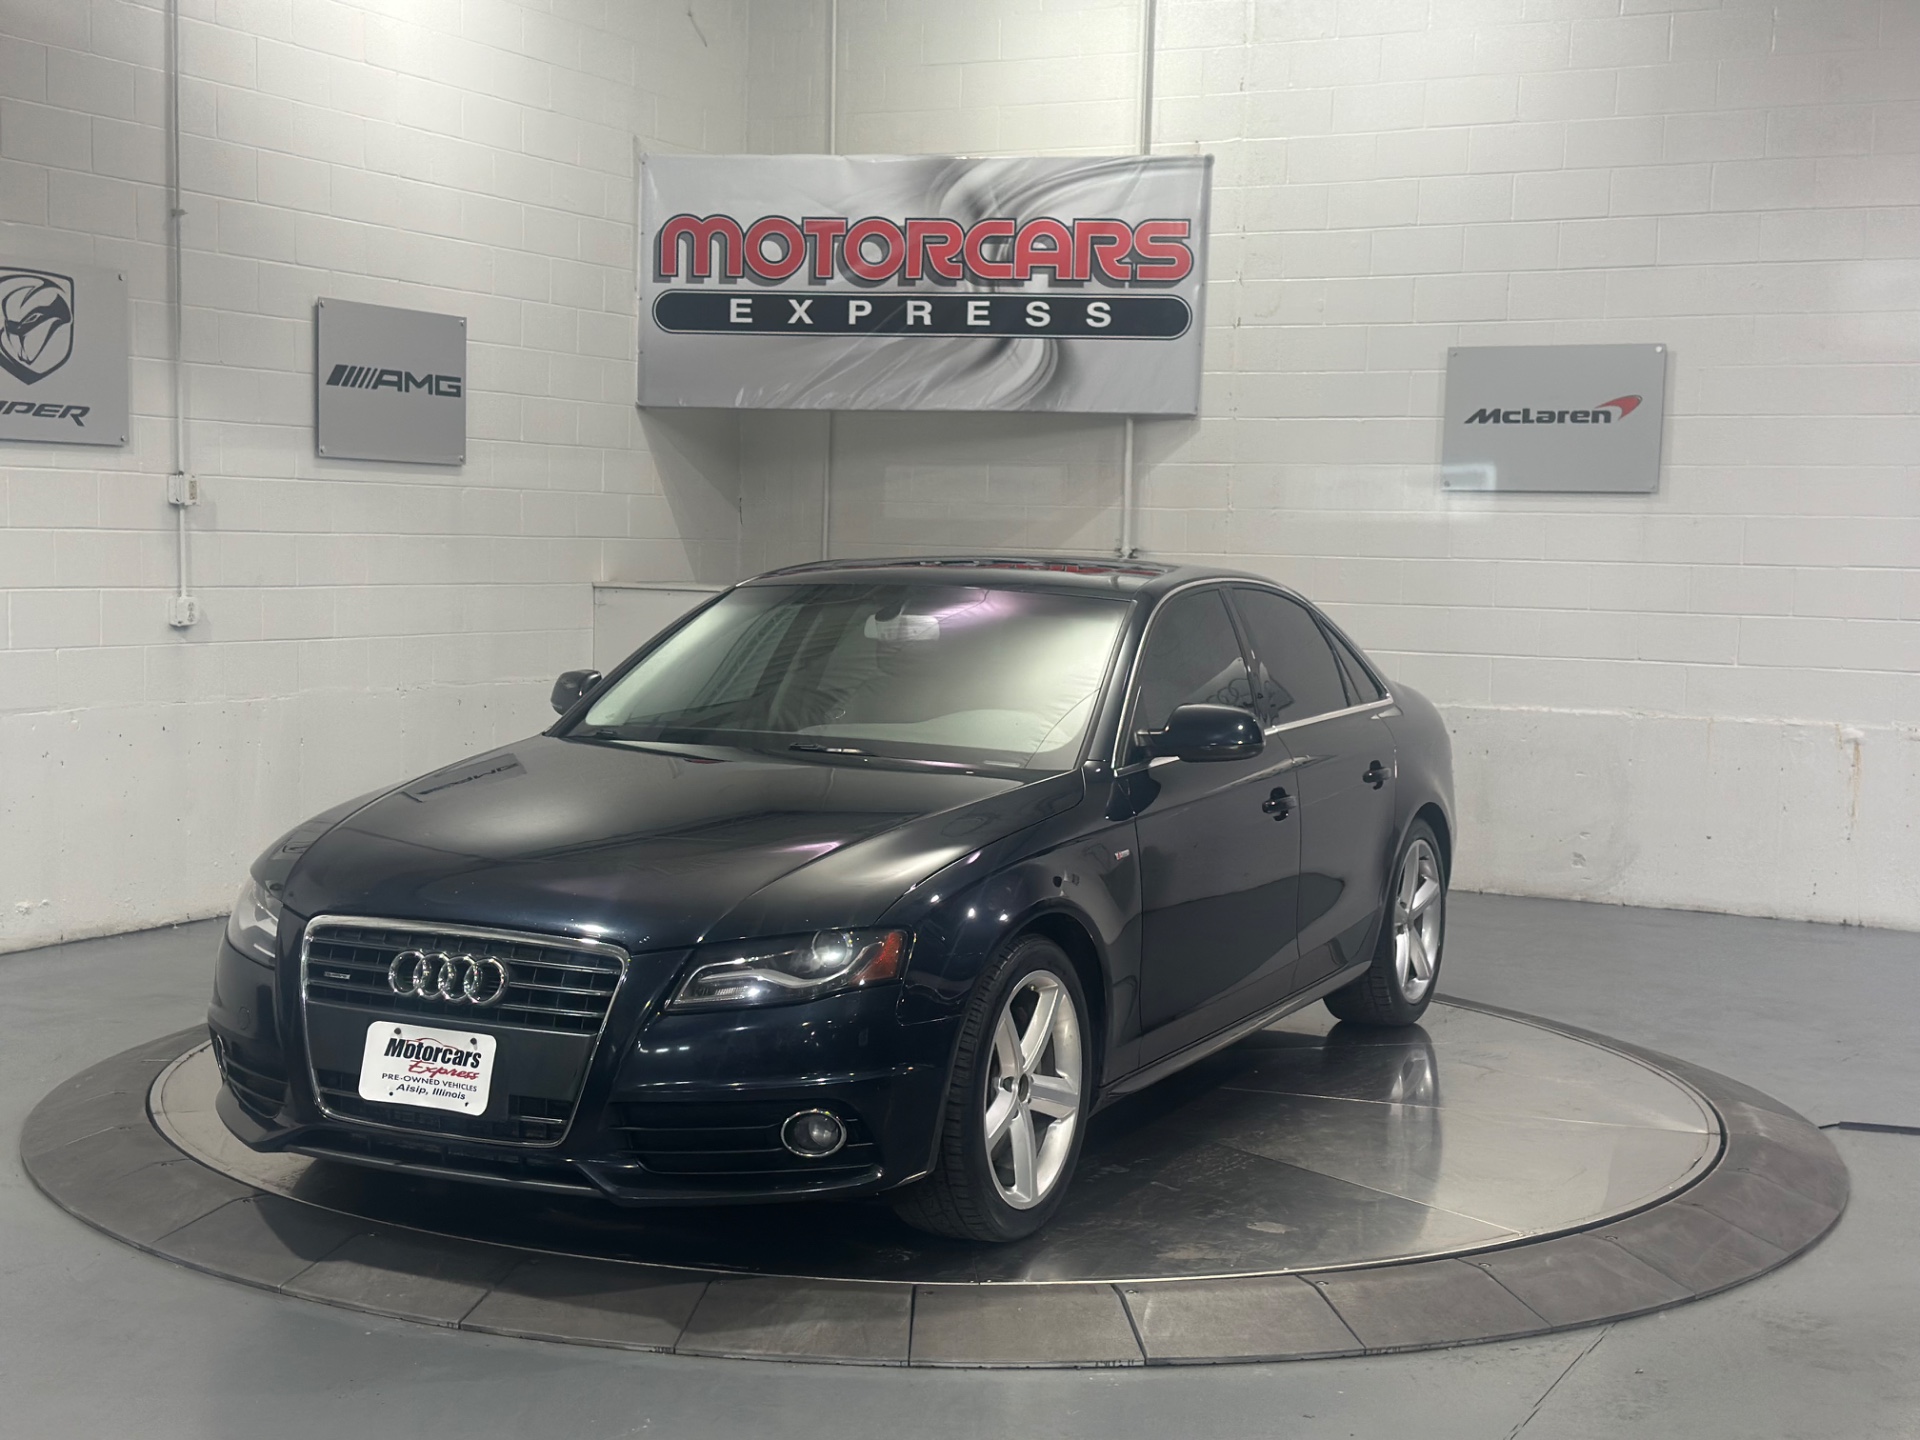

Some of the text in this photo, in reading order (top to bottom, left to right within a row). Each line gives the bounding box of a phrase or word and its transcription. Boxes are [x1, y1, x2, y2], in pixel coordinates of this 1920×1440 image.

[655, 214, 1195, 287] MOTORCARS
[729, 299, 1112, 328] EXPRESS
[371, 369, 462, 398] AMG
[1464, 408, 1612, 425] McLaren
[384, 1037, 482, 1069] Motorcars
[381, 1072, 478, 1093] PRE-OWNED VEHICLES
[408, 1060, 480, 1081] Express
[432, 1087, 466, 1101] Illinois
